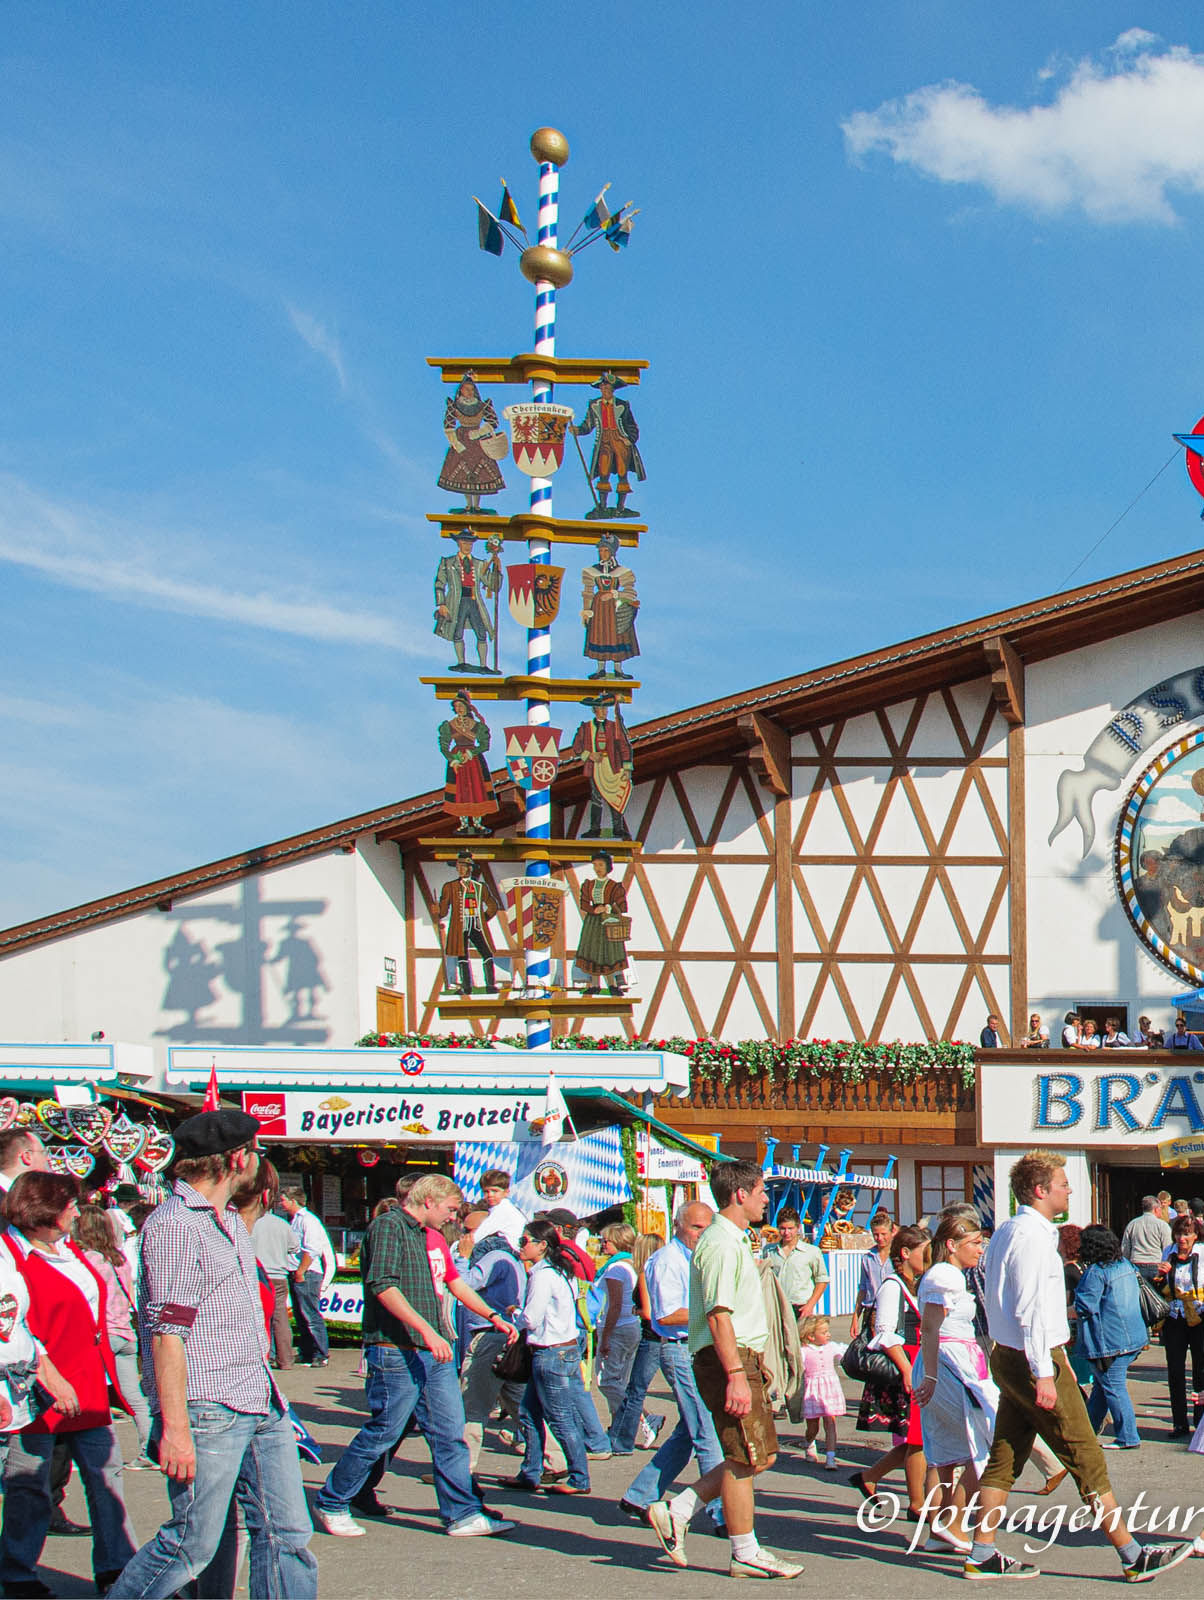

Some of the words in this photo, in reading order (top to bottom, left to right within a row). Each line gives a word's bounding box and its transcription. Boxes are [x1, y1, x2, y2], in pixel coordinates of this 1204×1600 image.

[250, 1103, 281, 1115] Coca-Cola
[301, 1099, 425, 1135] Bayerische
[437, 1101, 530, 1130] Brotzeit
